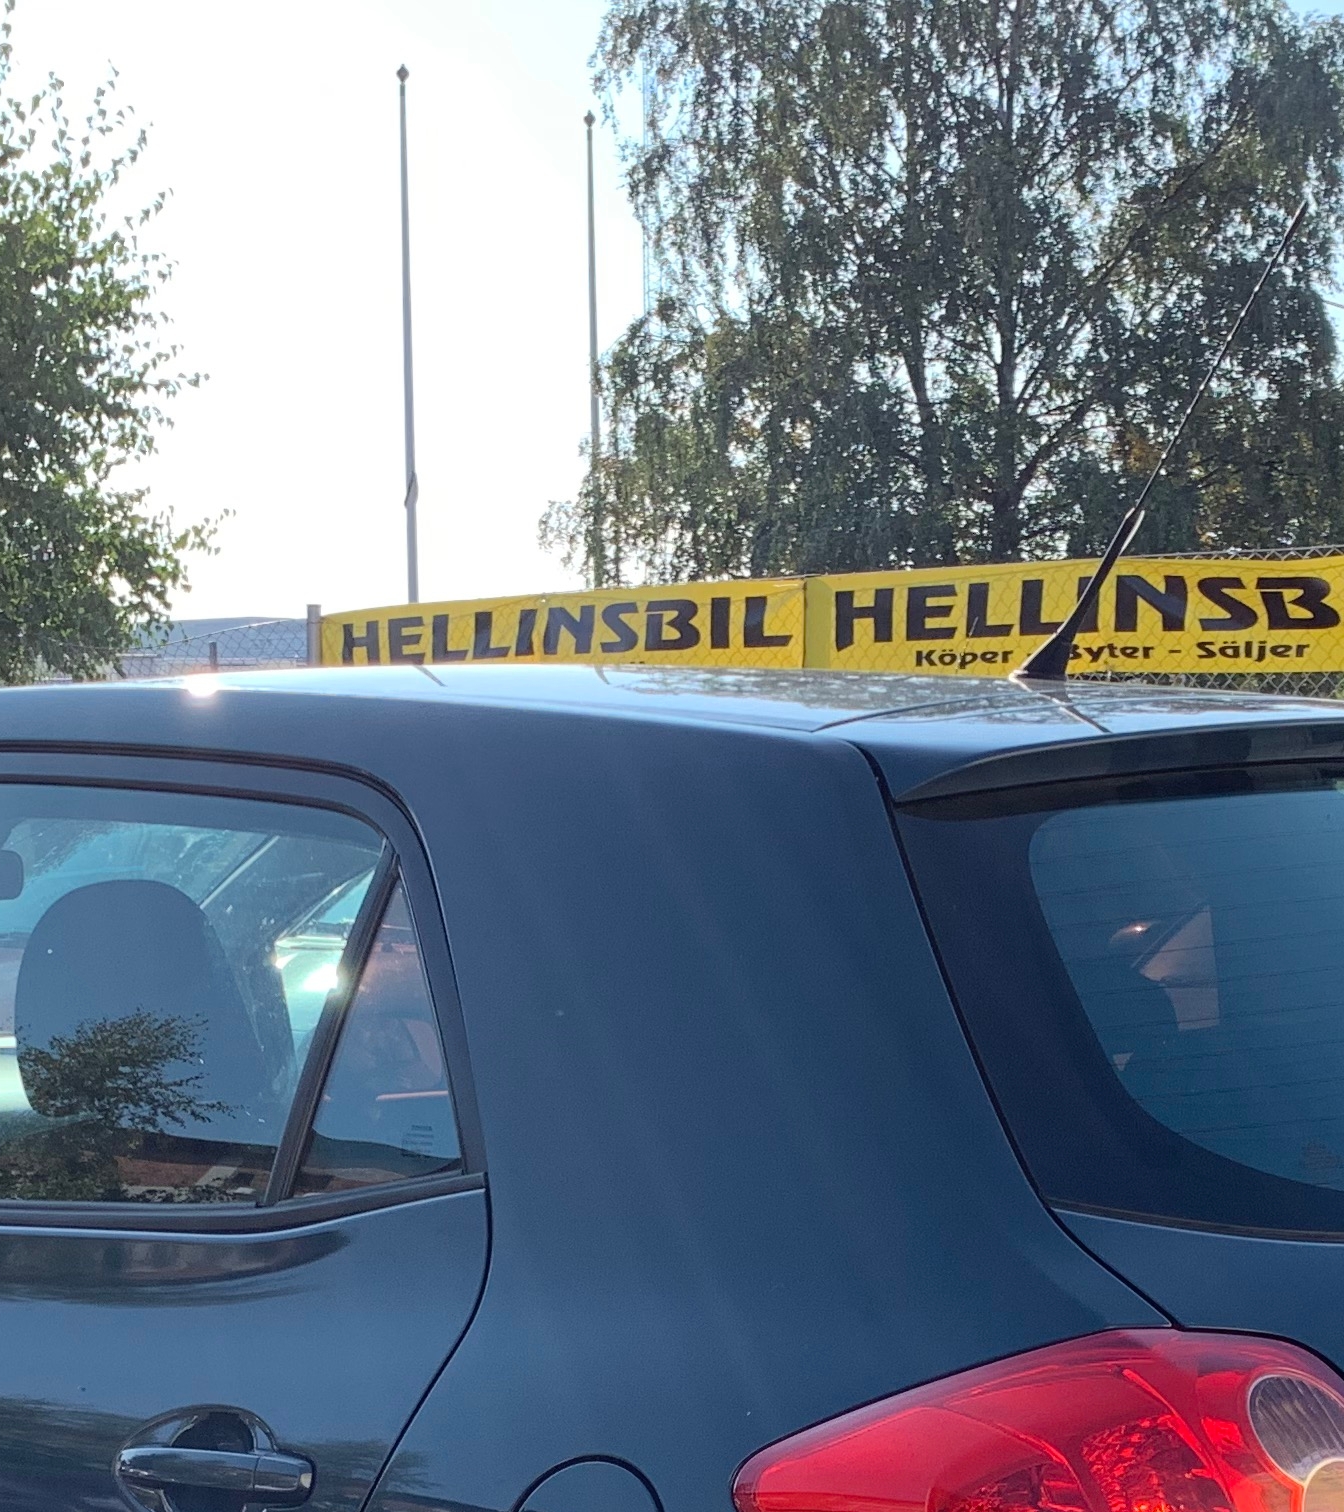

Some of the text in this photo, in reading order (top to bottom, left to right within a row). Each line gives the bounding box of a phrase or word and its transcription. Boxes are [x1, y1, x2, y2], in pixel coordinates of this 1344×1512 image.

[341, 596, 793, 665] HELLINSBIL
[915, 649, 1013, 669] Köper
[1196, 640, 1311, 663] Säljer
